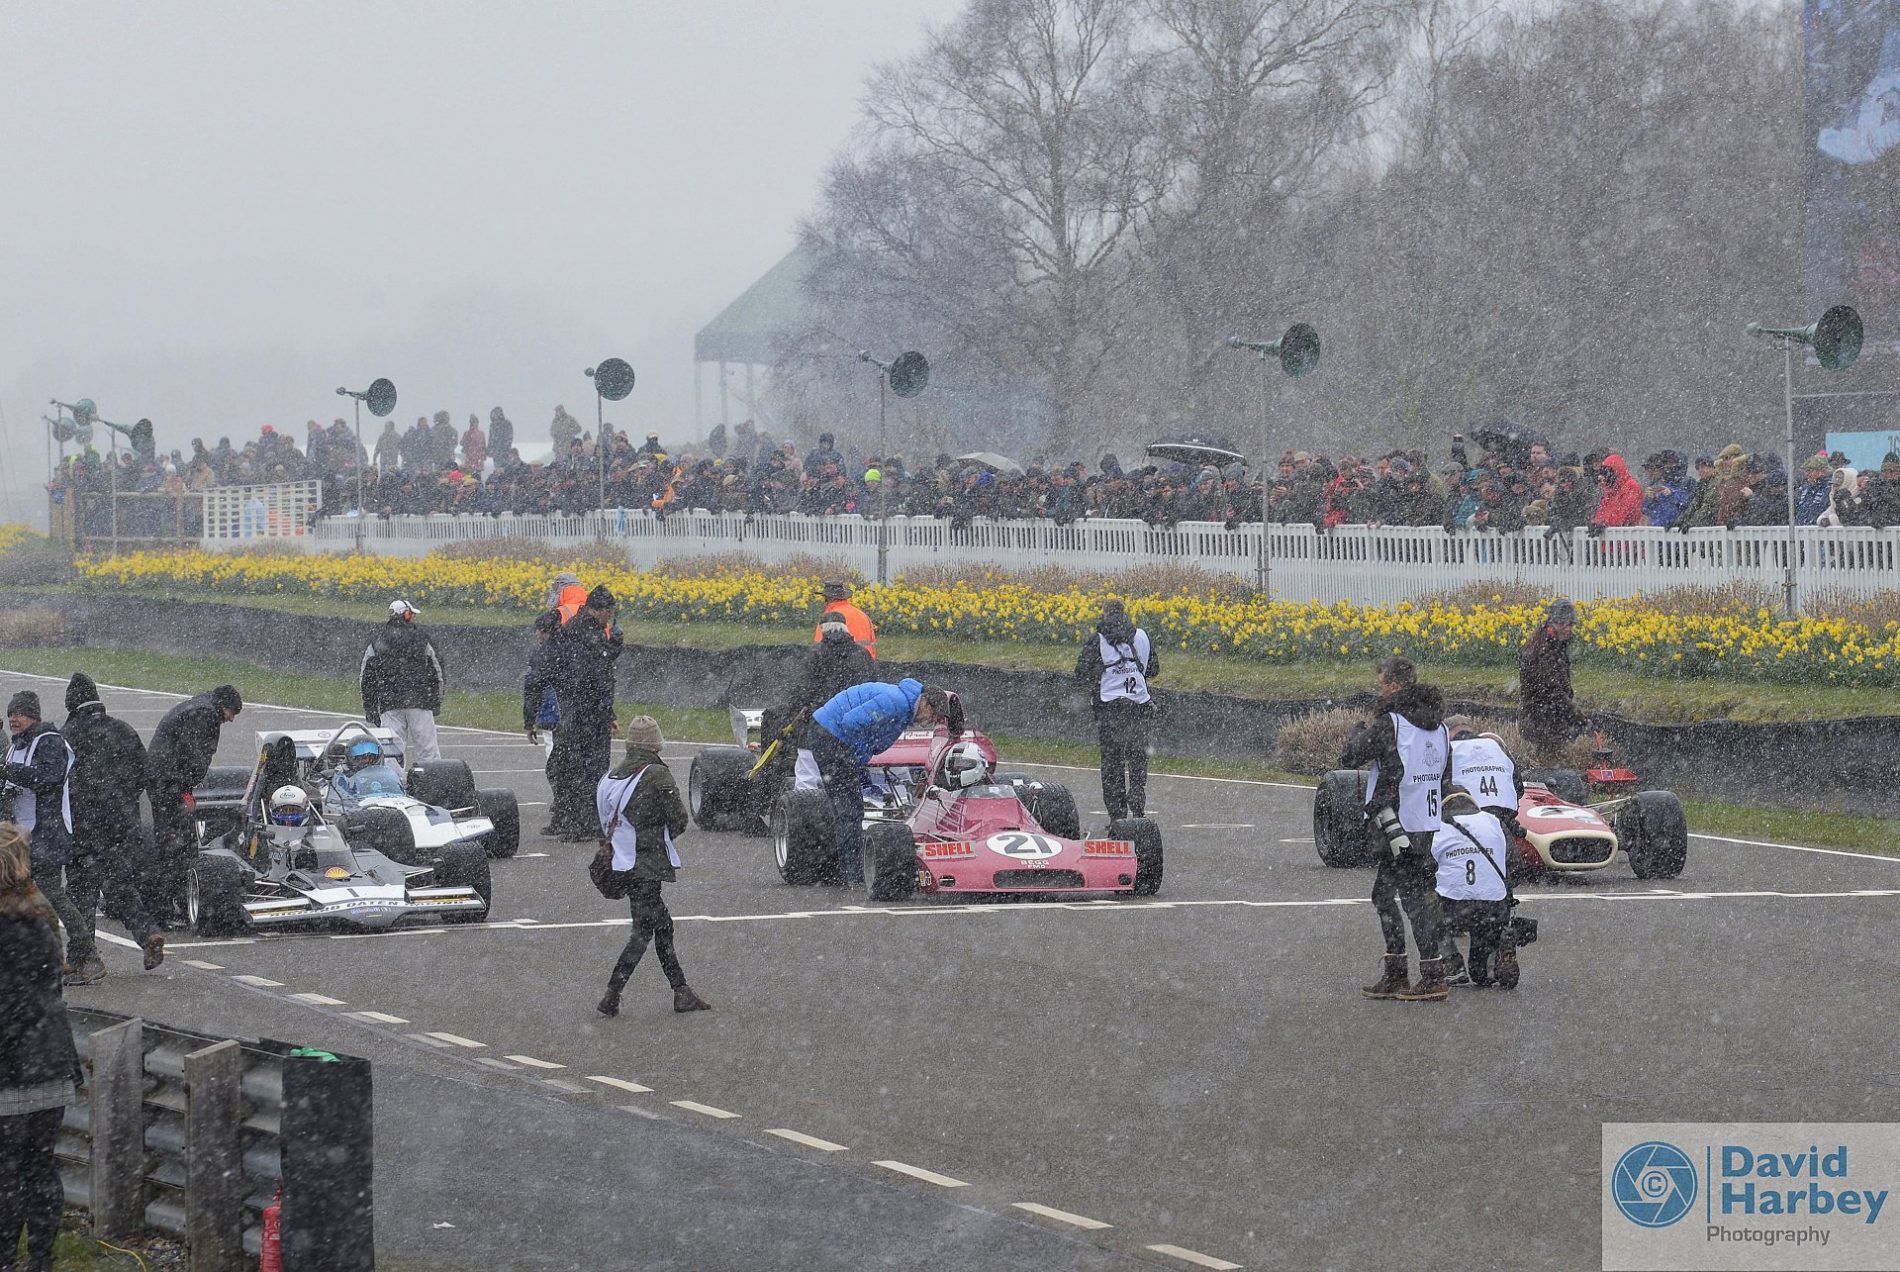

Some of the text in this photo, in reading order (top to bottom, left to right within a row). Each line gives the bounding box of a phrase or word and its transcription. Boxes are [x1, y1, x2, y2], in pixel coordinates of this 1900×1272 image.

[1123, 677, 1137, 695] 12
[1461, 765, 1506, 776] PHOTOGRAPHER
[1479, 775, 1498, 797] 44
[1426, 788, 1438, 817] 15
[924, 841, 974, 857] SHELL
[996, 834, 1053, 854] 21
[1084, 840, 1132, 855] SHELL
[1465, 859, 1476, 885] 8
